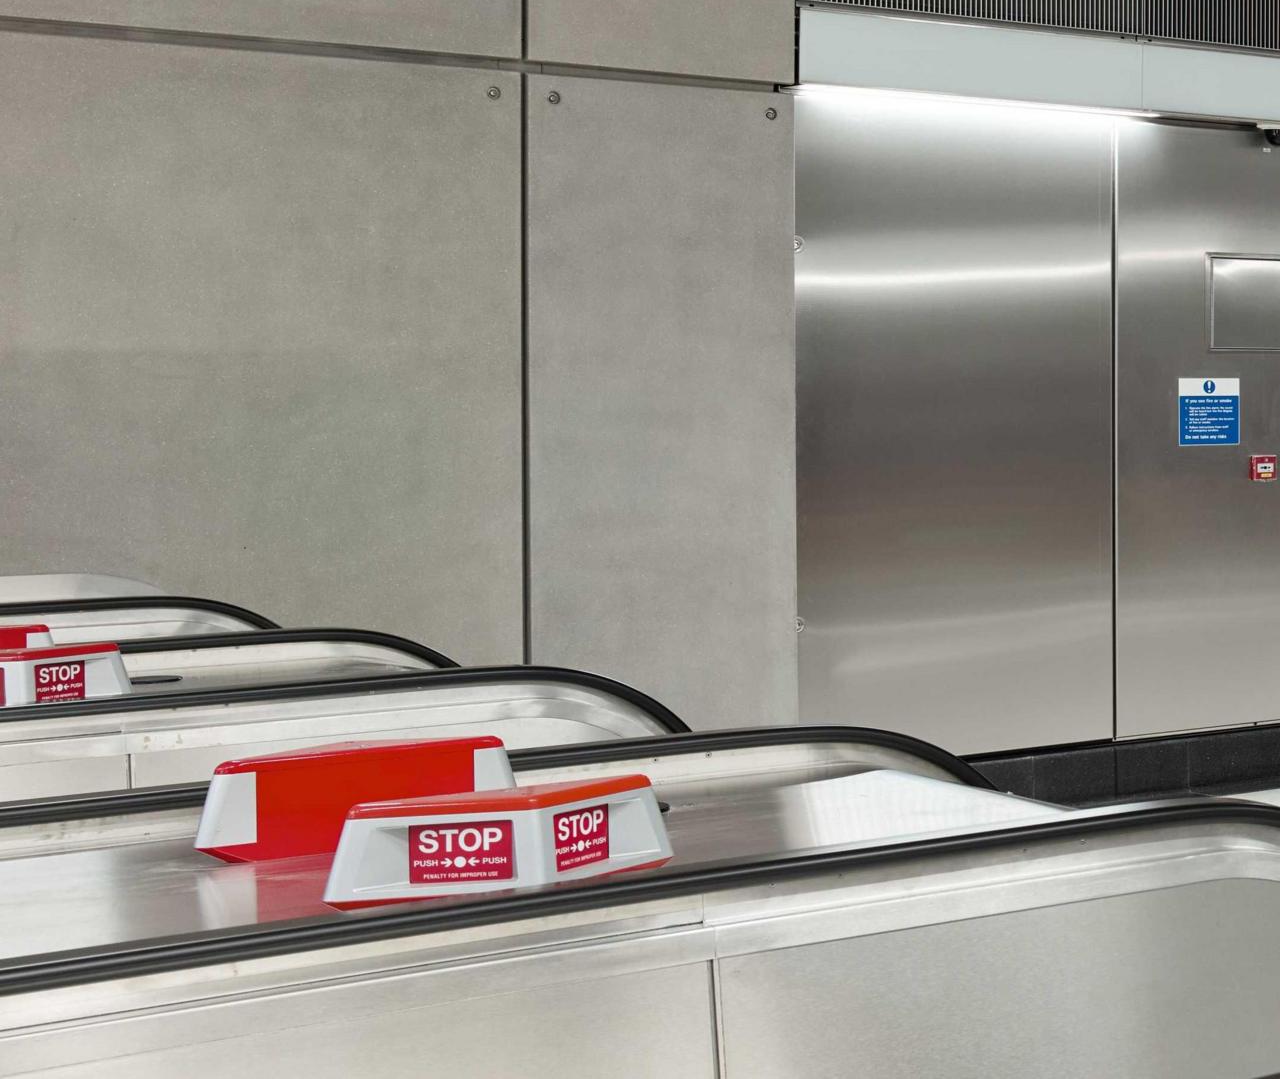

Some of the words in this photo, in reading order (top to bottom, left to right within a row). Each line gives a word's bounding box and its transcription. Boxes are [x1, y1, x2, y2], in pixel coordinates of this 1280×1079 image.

[39, 664, 81, 684] STOP
[558, 809, 604, 841] STOP
[418, 827, 503, 854] STOP
[555, 846, 570, 855] PUSH
[592, 836, 607, 846] PUSH
[413, 859, 439, 868] PUSH
[482, 856, 507, 865] PUSH
